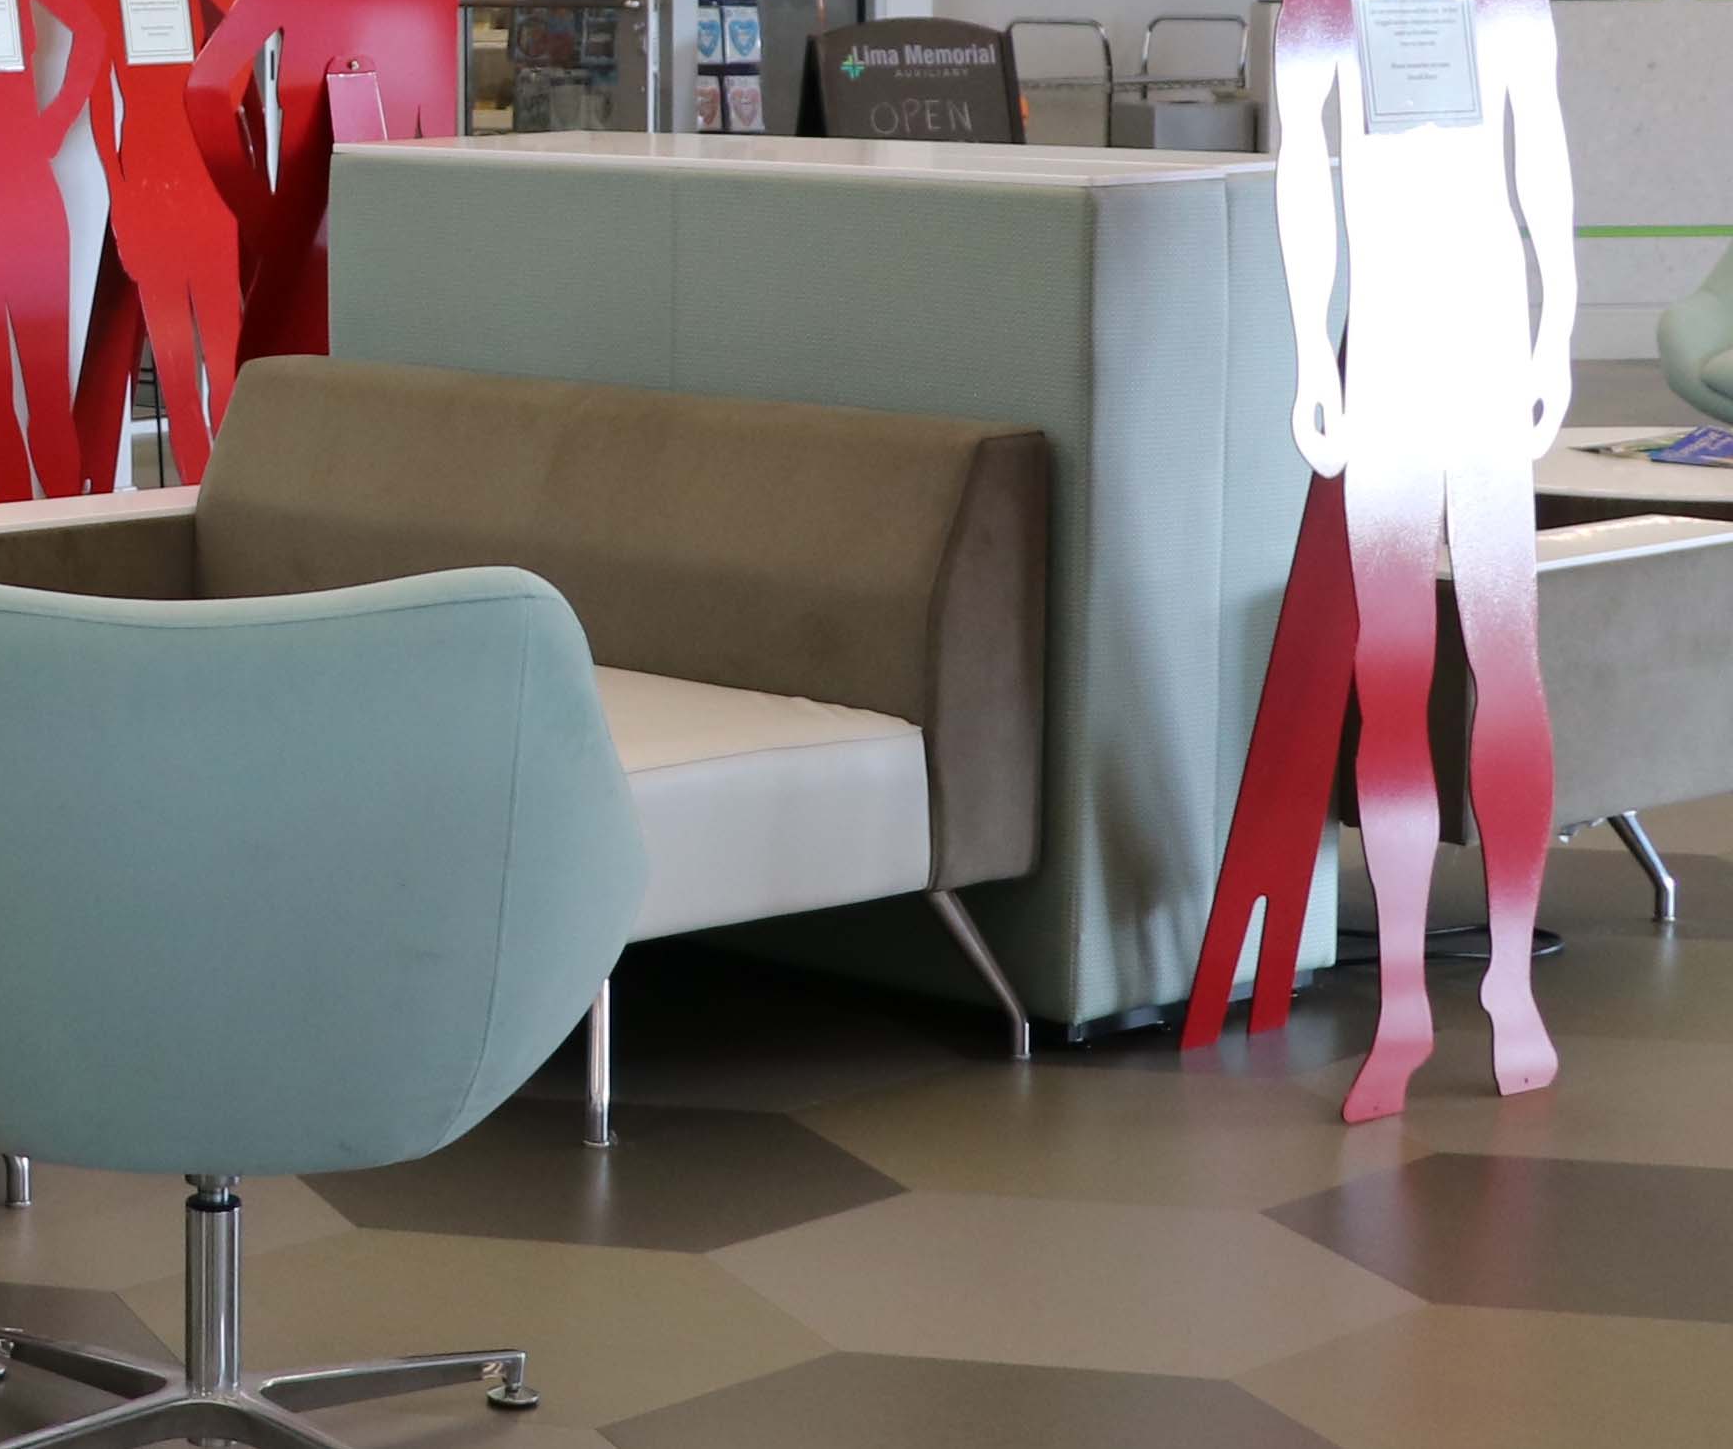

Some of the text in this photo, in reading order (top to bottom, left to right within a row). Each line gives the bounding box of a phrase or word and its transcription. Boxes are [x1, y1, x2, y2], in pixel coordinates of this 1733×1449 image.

[853, 44, 996, 64] Lima Memorial
[870, 99, 973, 134] OPEN
